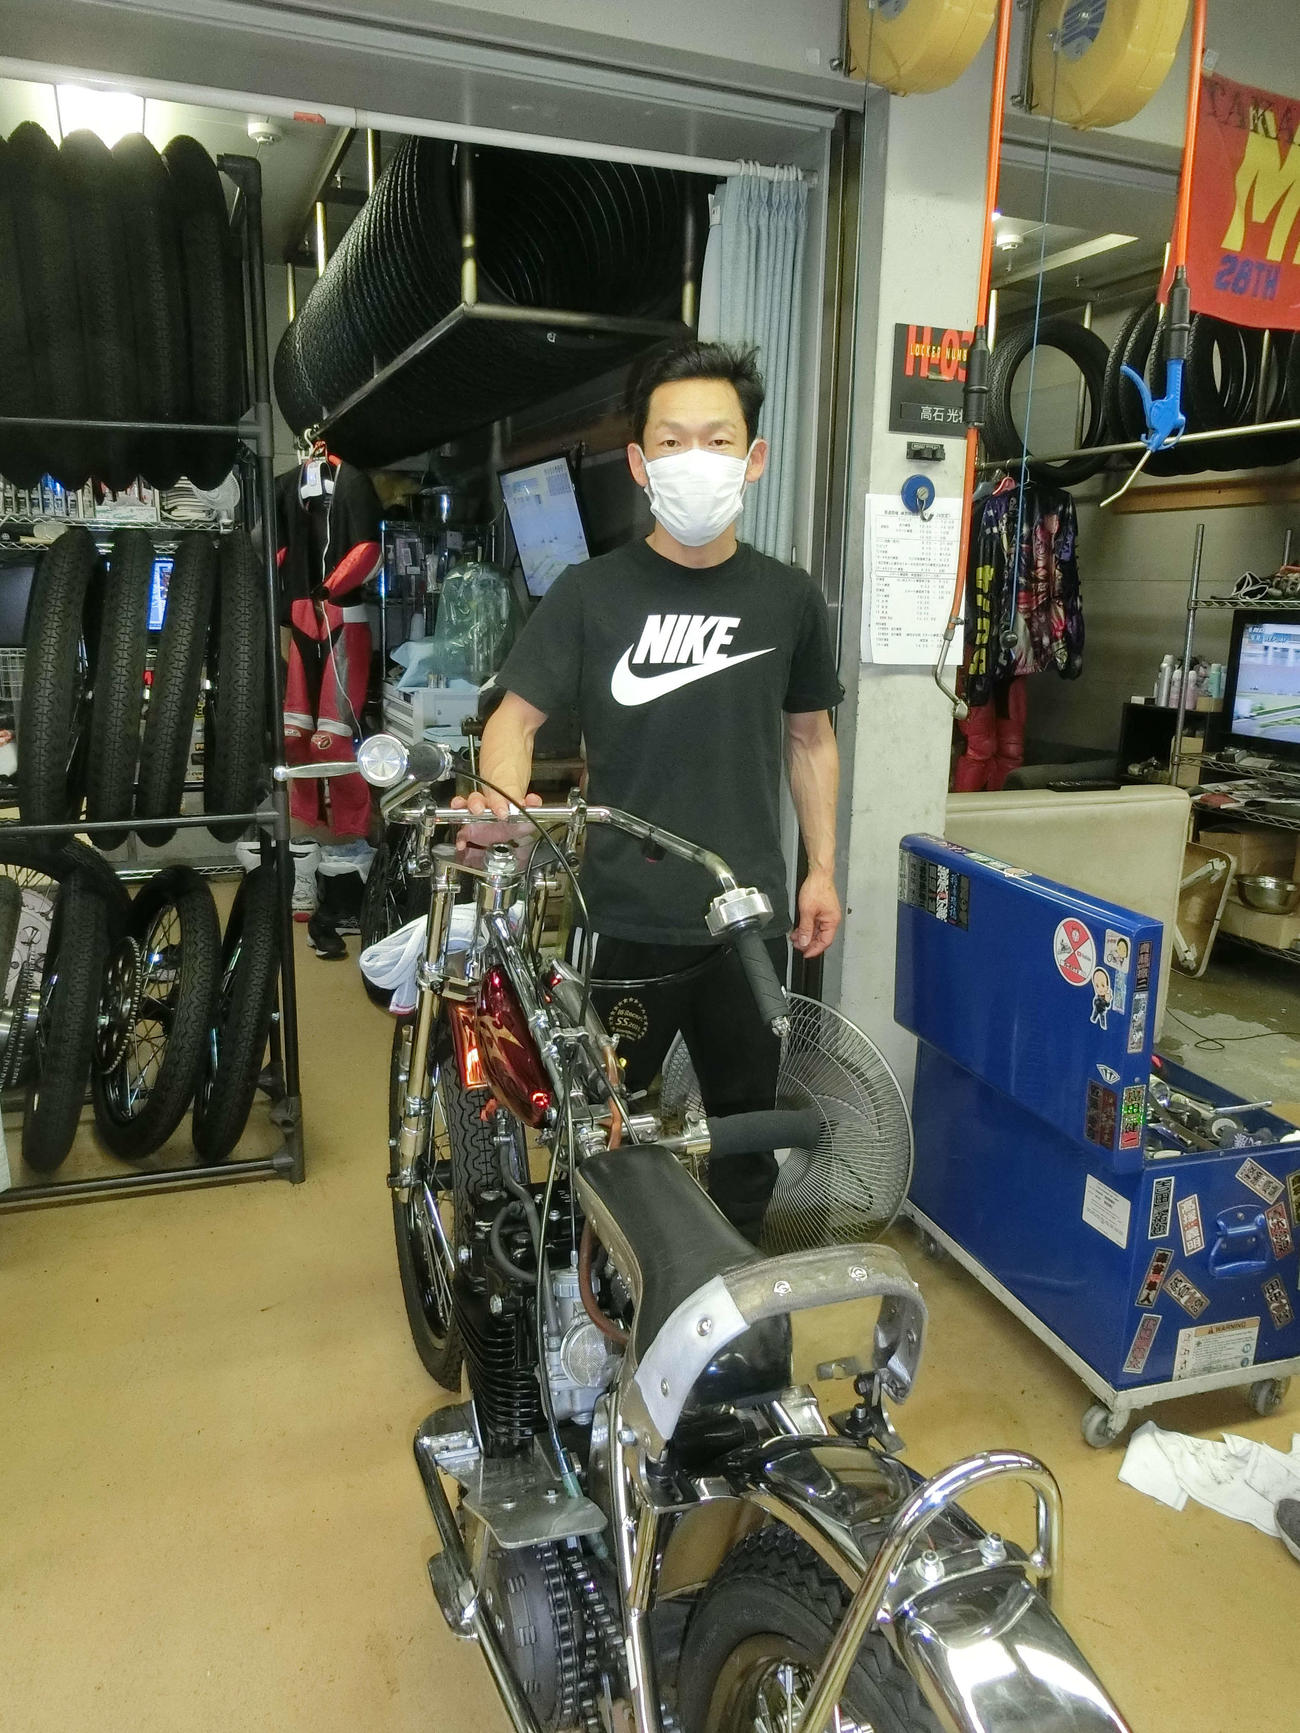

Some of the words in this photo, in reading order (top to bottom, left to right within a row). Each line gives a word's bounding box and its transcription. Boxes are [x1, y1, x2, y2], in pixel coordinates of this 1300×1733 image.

[1213, 253, 1283, 301] 28TH
[910, 343, 941, 359] LOCKER
[920, 406, 945, 422] 高石
[631, 614, 741, 664] NIKE
[1215, 1321, 1247, 1333] WARNING
